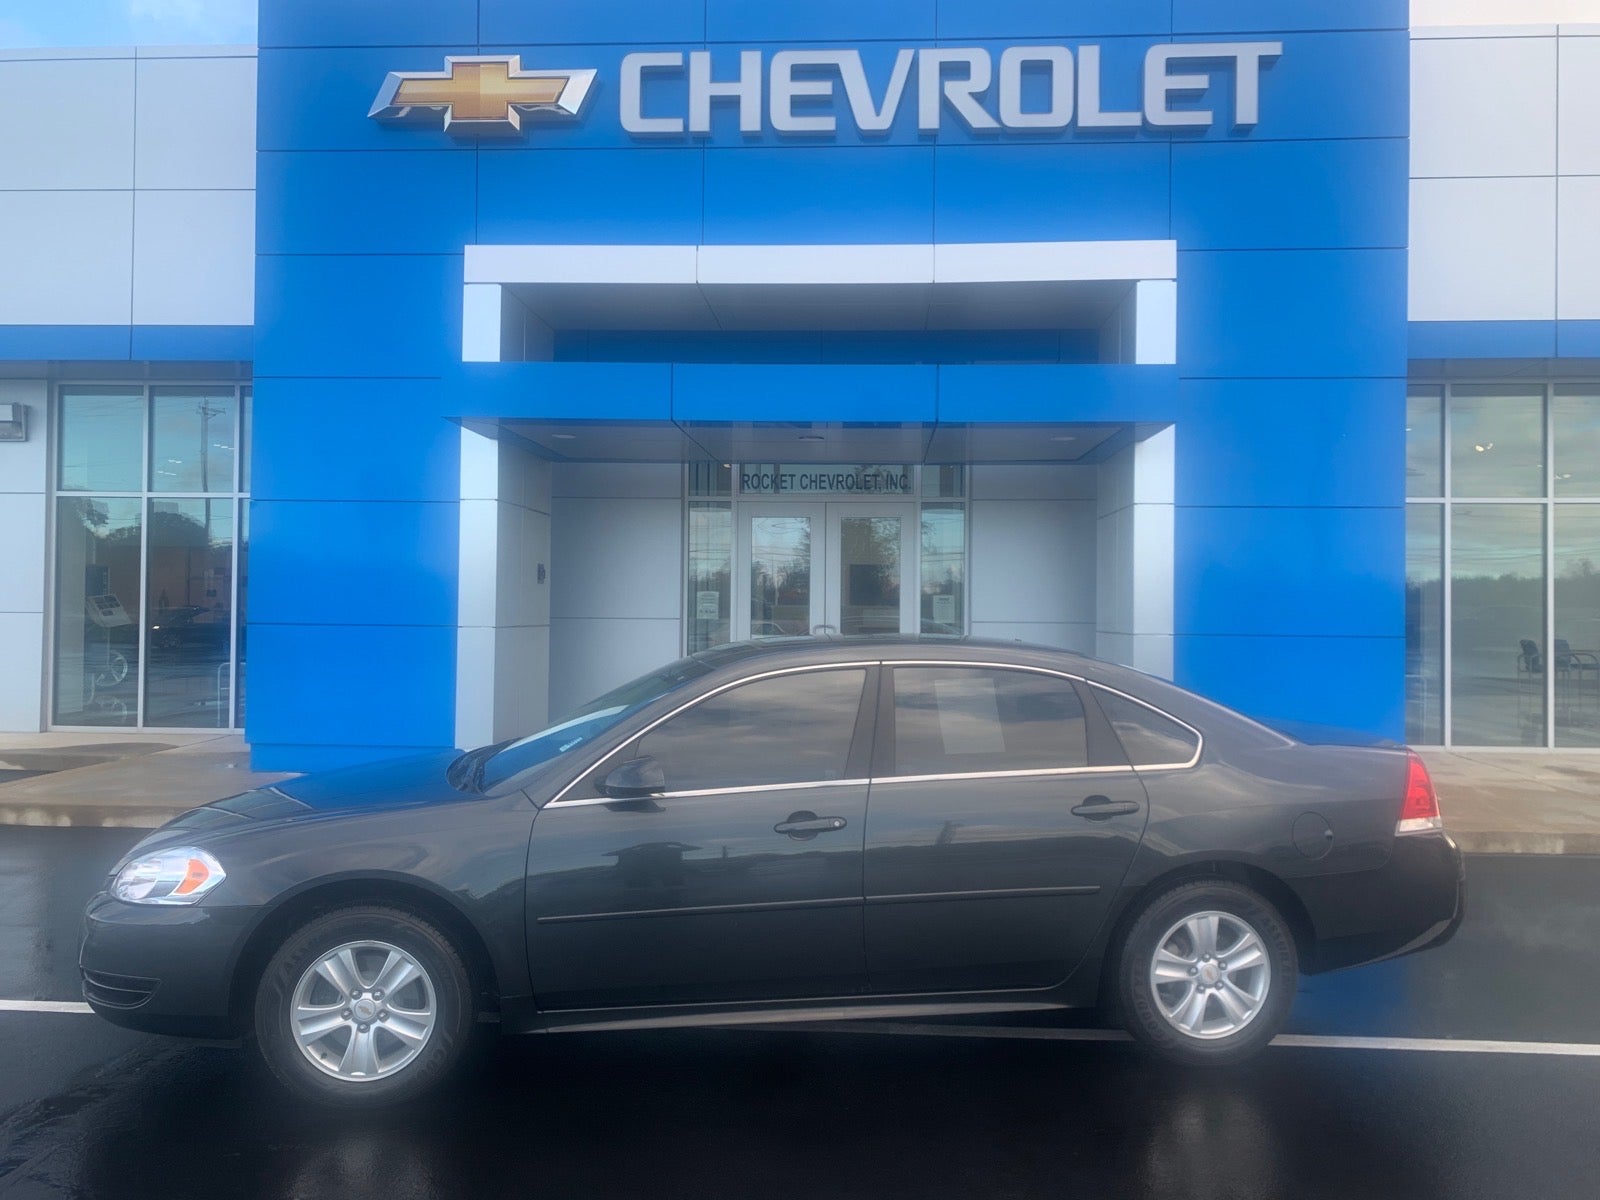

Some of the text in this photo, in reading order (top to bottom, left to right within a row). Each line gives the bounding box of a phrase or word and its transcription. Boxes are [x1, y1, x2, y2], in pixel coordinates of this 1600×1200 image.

[620, 41, 1283, 134] CHEVROLET
[741, 473, 797, 490] ROCKET
[885, 473, 911, 490] INC.
